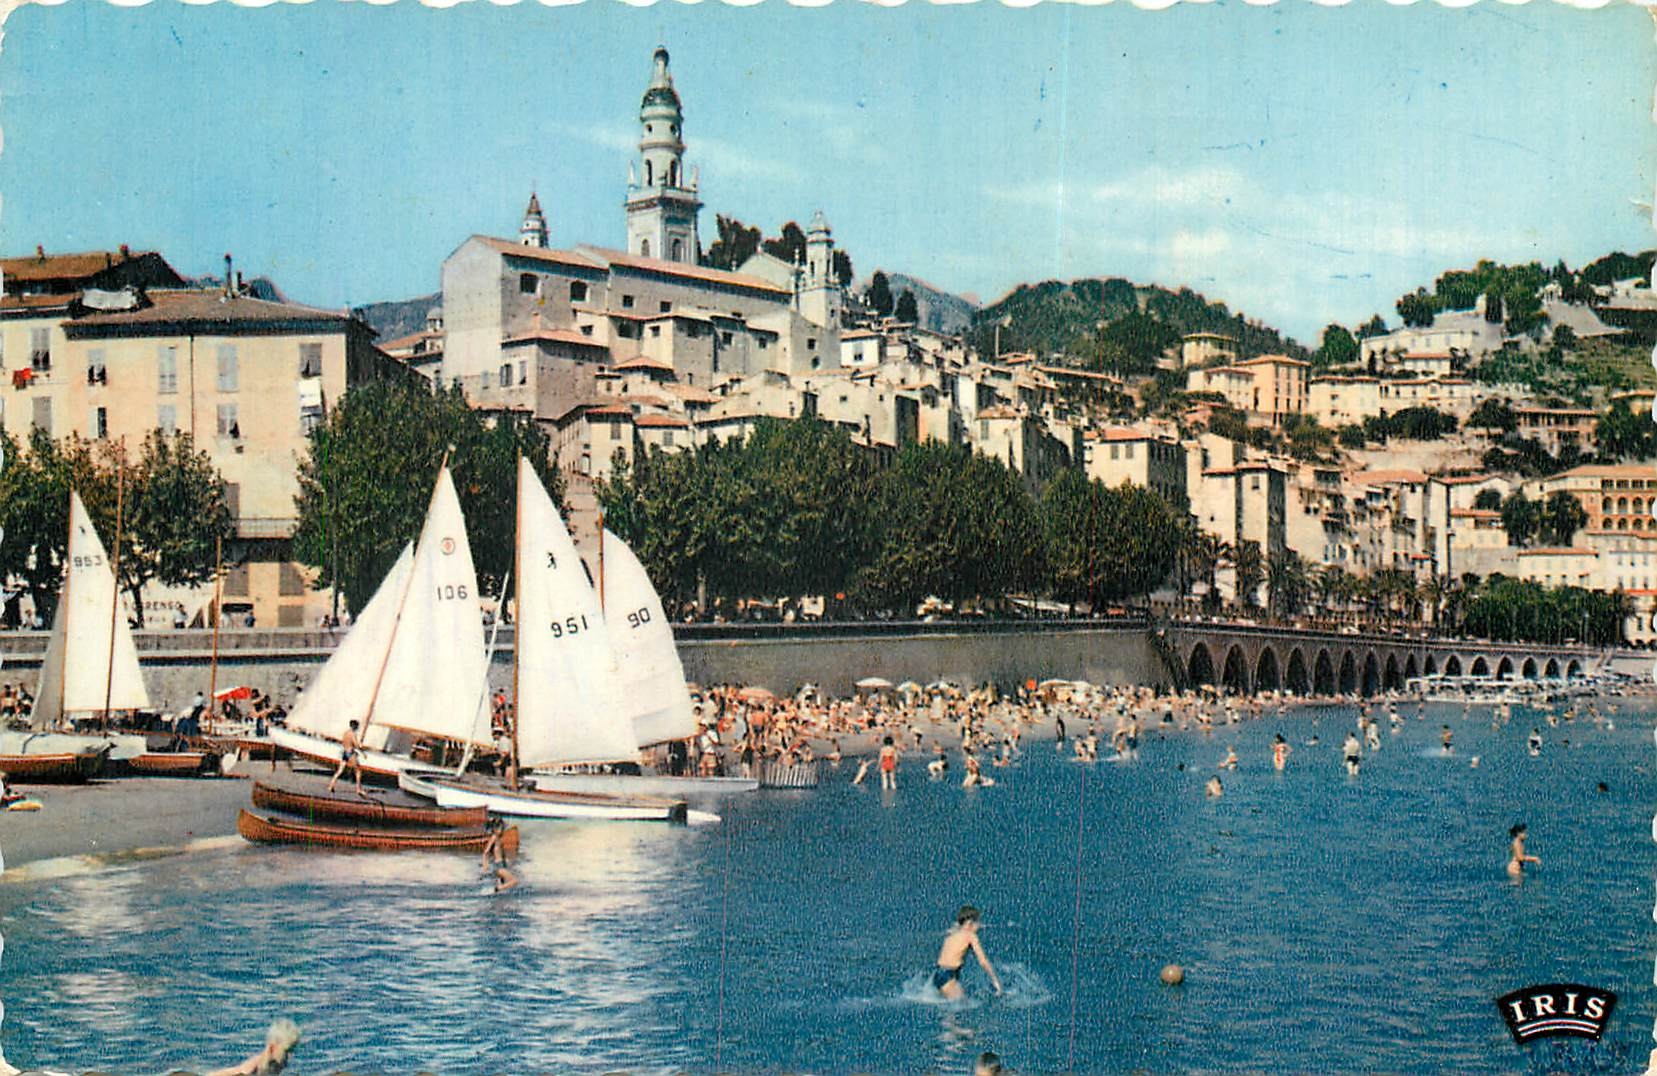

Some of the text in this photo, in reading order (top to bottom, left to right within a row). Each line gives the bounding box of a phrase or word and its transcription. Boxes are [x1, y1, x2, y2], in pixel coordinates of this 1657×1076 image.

[437, 585, 468, 601] 106
[551, 614, 588, 638] 951
[627, 607, 651, 629] 90
